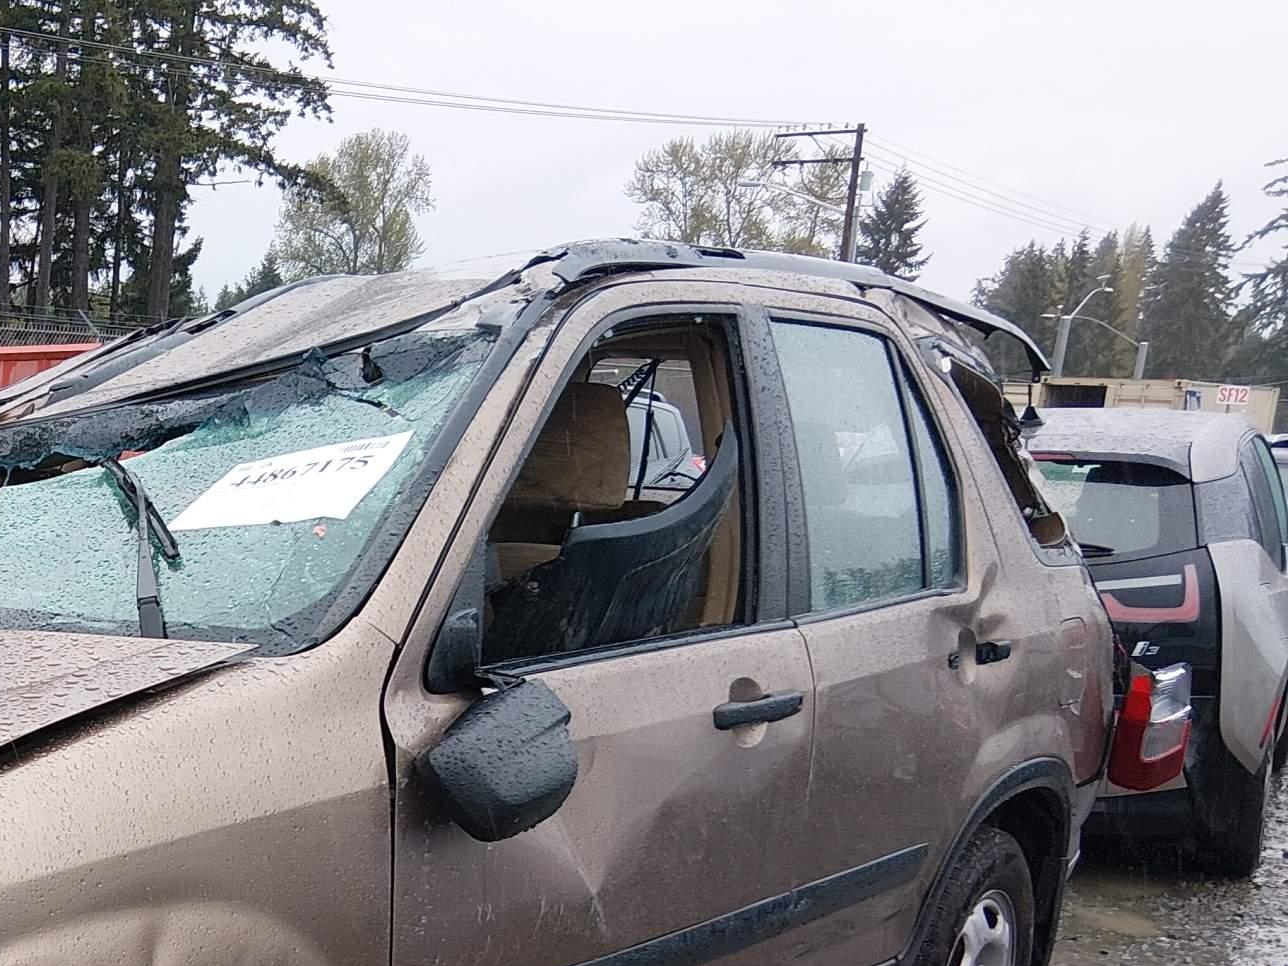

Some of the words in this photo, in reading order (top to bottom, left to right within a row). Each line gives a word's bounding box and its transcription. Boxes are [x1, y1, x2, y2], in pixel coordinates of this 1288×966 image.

[1219, 388, 1248, 403] SF12
[230, 455, 374, 488] 44867175
[1130, 641, 1160, 657] i3
